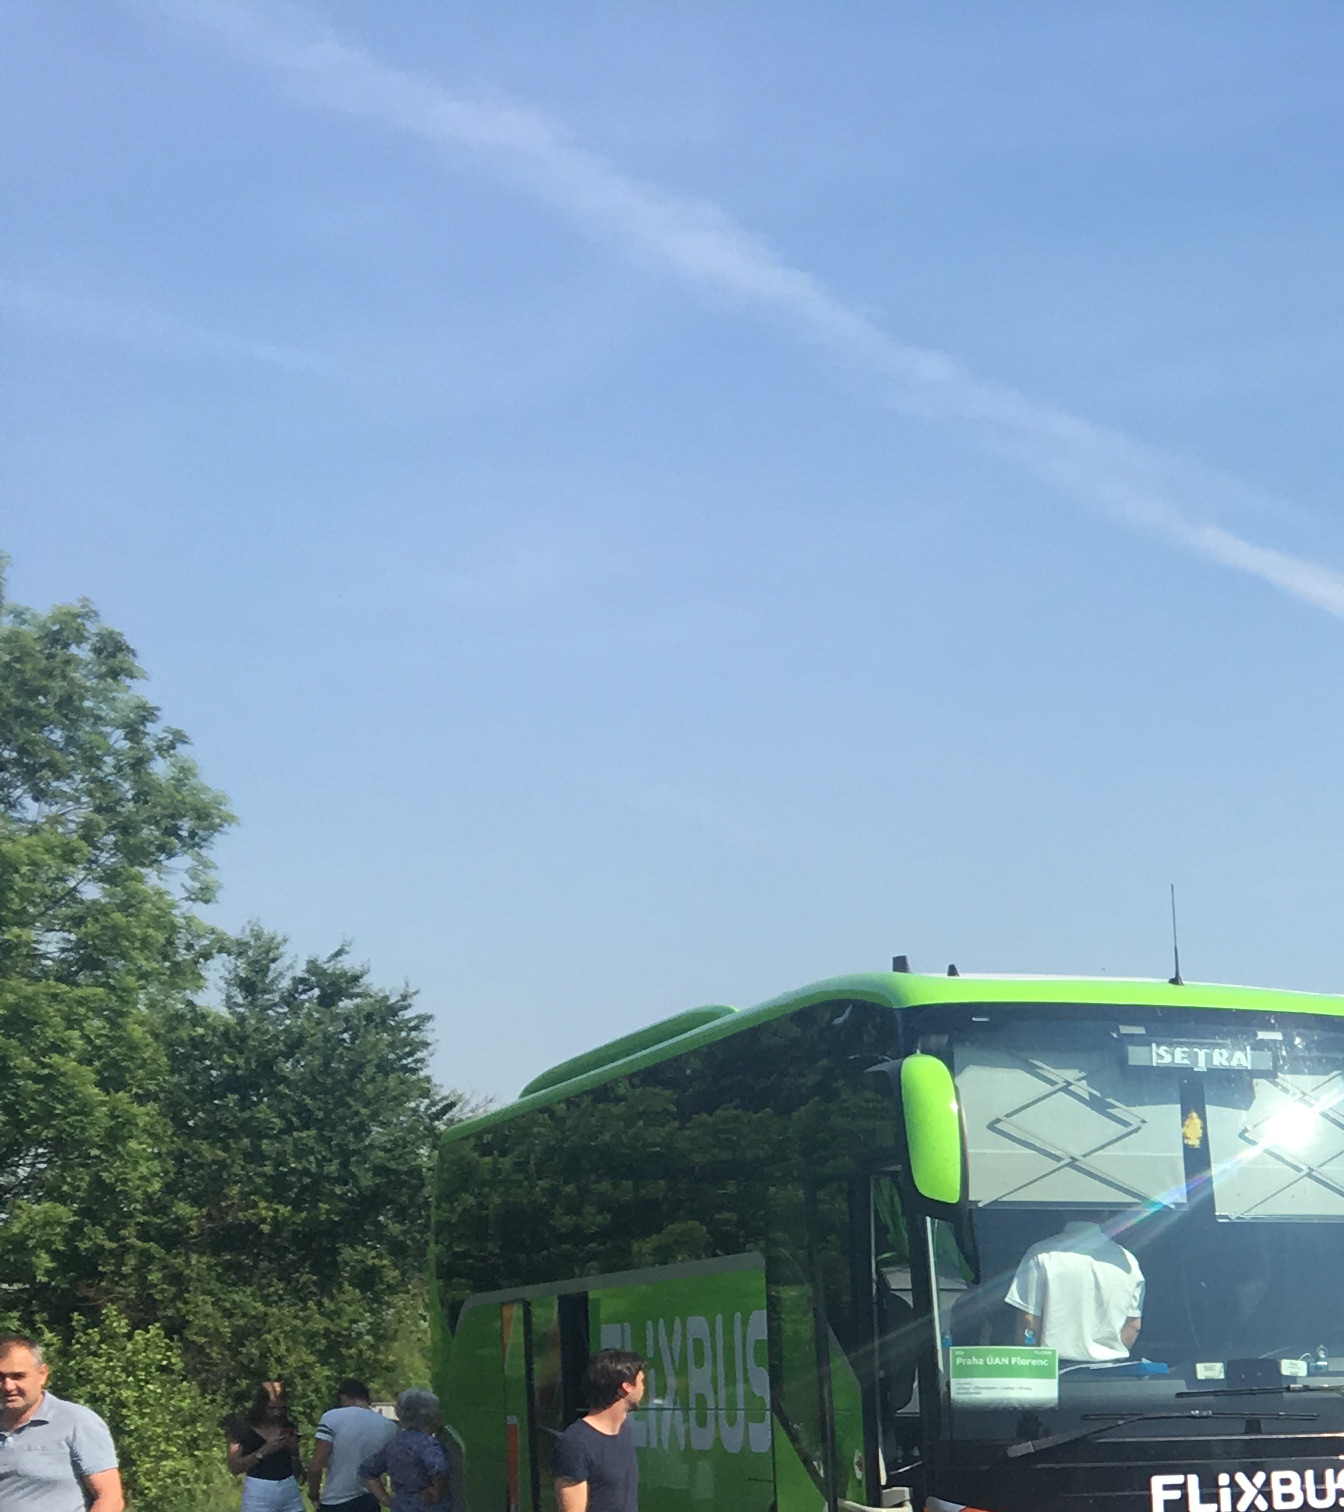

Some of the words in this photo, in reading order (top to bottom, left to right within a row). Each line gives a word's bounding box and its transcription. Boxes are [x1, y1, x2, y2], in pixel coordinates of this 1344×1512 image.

[1156, 1045, 1247, 1067] SETRA
[955, 1356, 984, 1366] Praha
[986, 1354, 1009, 1366] ÚAN
[1011, 1356, 1049, 1366] Florenc
